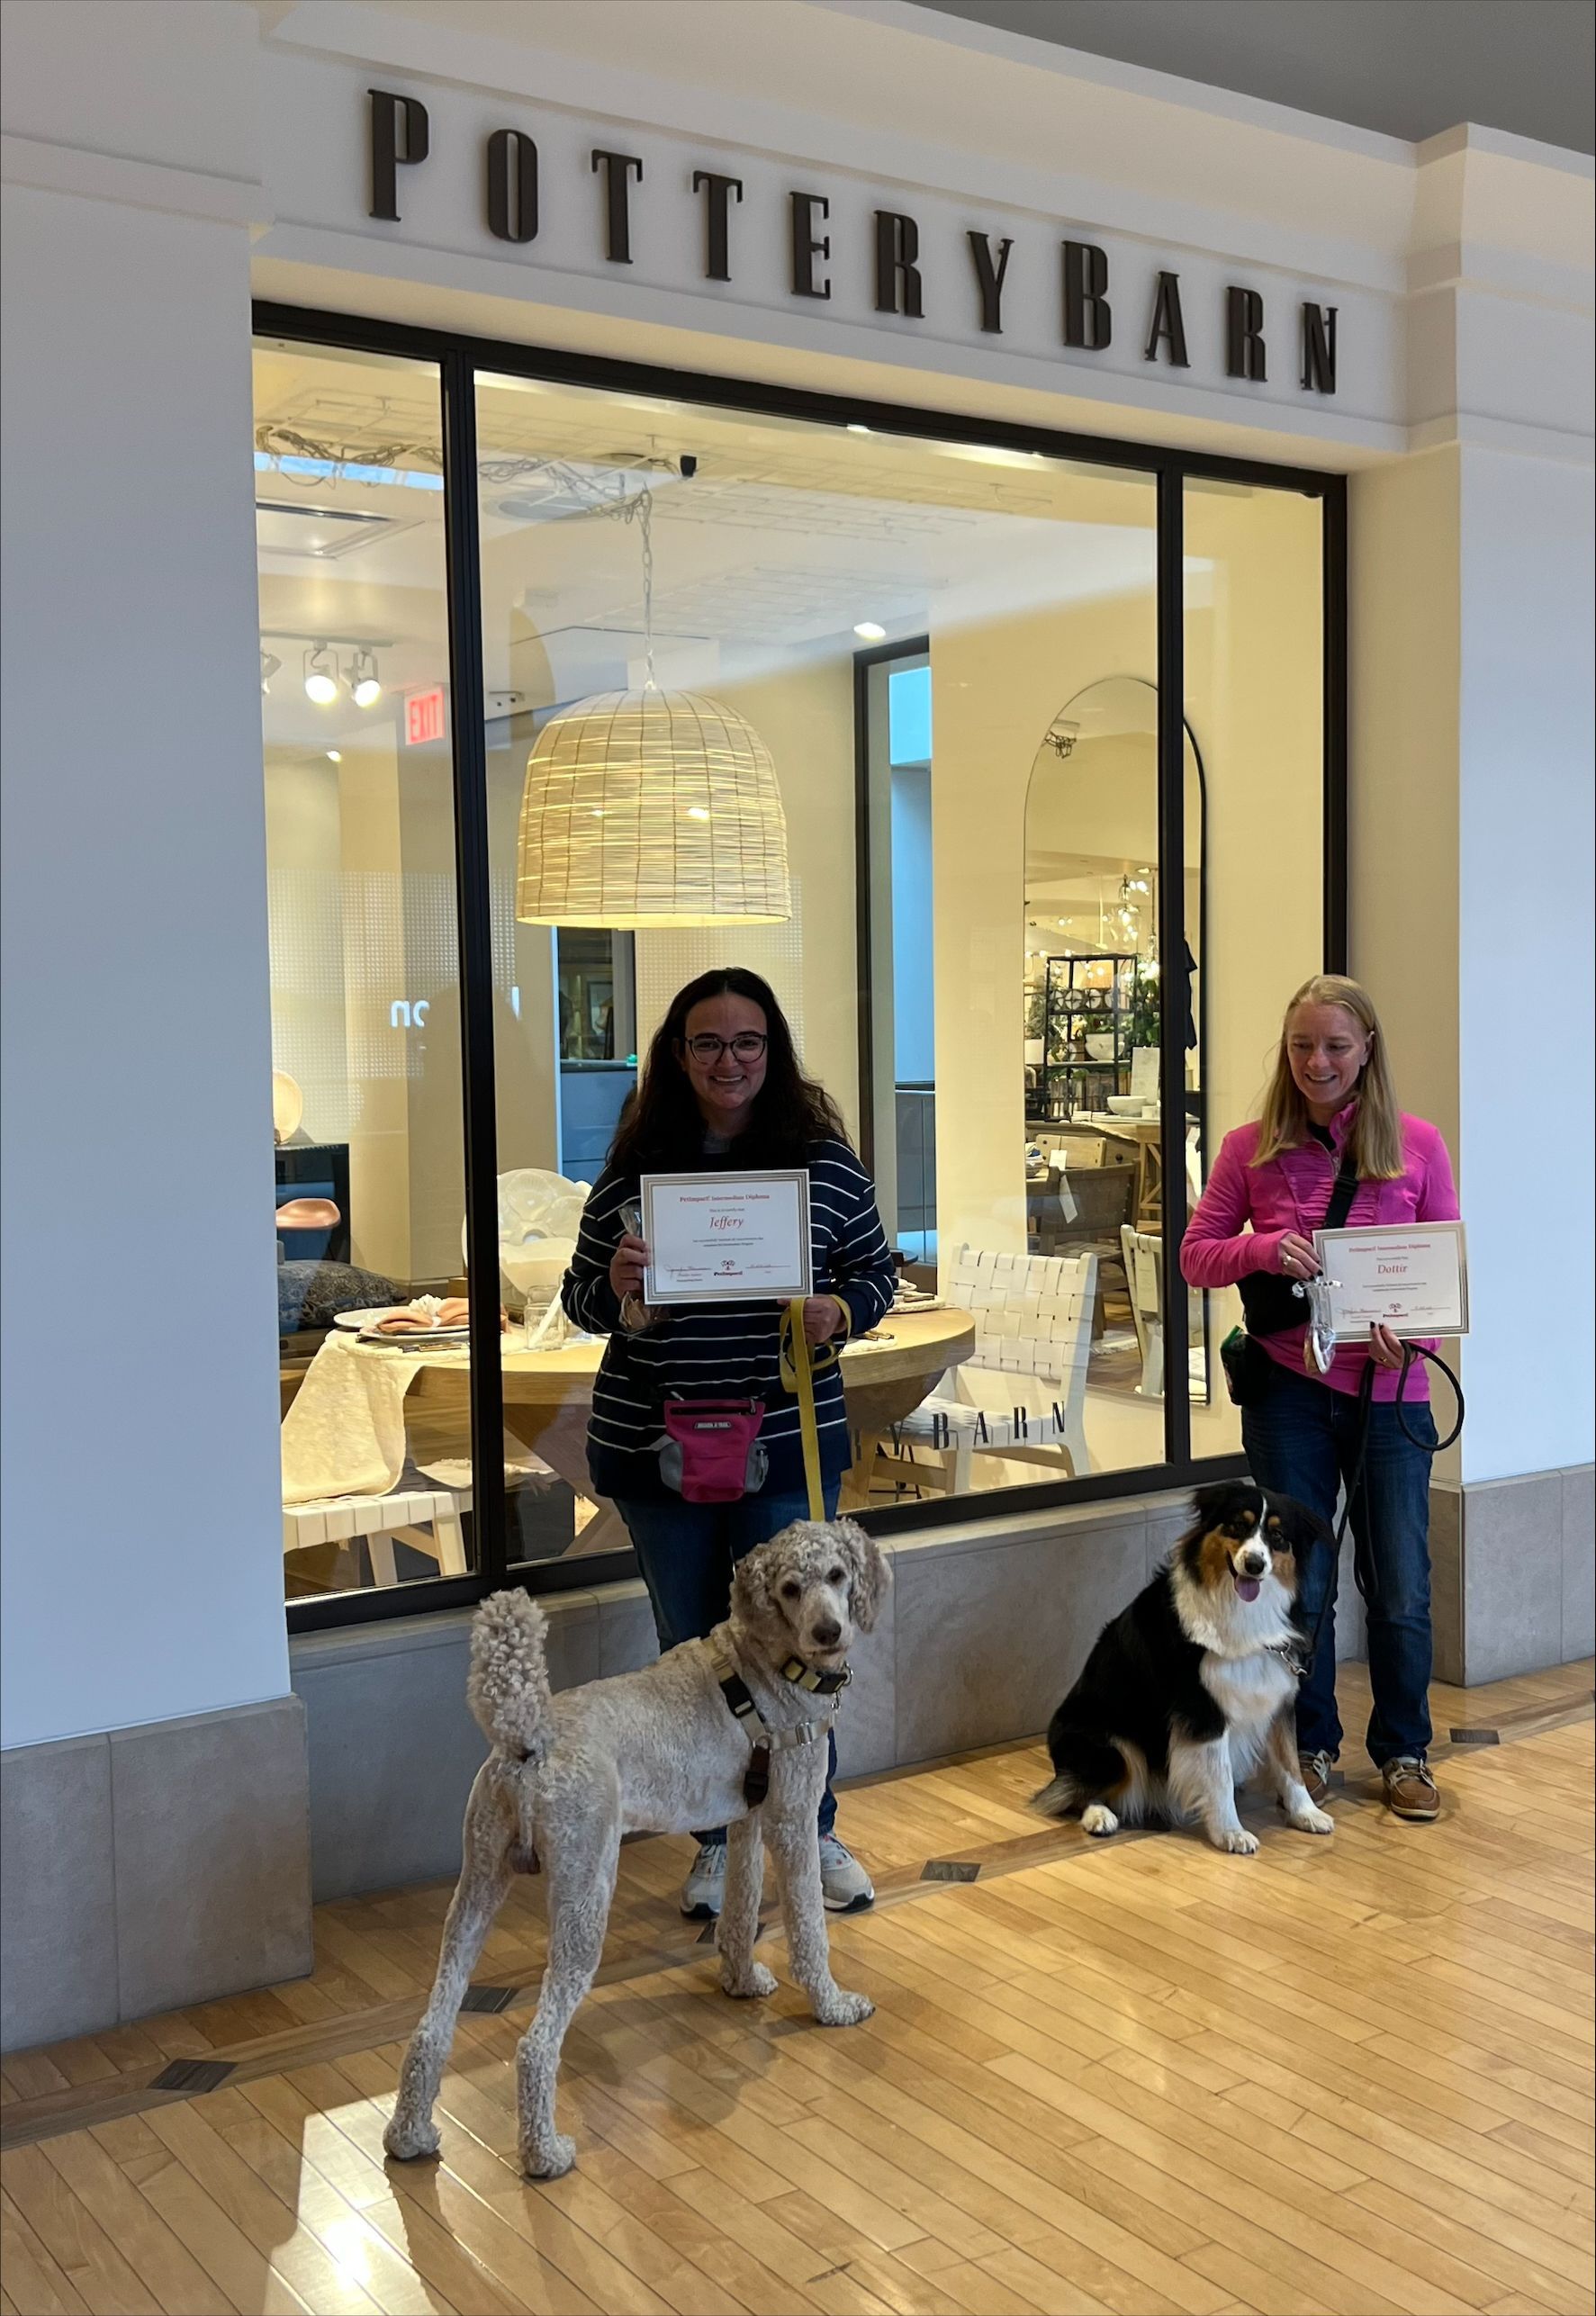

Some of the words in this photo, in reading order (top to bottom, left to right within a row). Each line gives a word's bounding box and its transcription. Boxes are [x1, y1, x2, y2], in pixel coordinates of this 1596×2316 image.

[366, 88, 1014, 334] POTTERY
[1061, 239, 1339, 395] BARN
[408, 694, 439, 743] EXIT
[709, 1215, 744, 1230] Jeffery
[932, 1401, 1066, 1450] BARN
